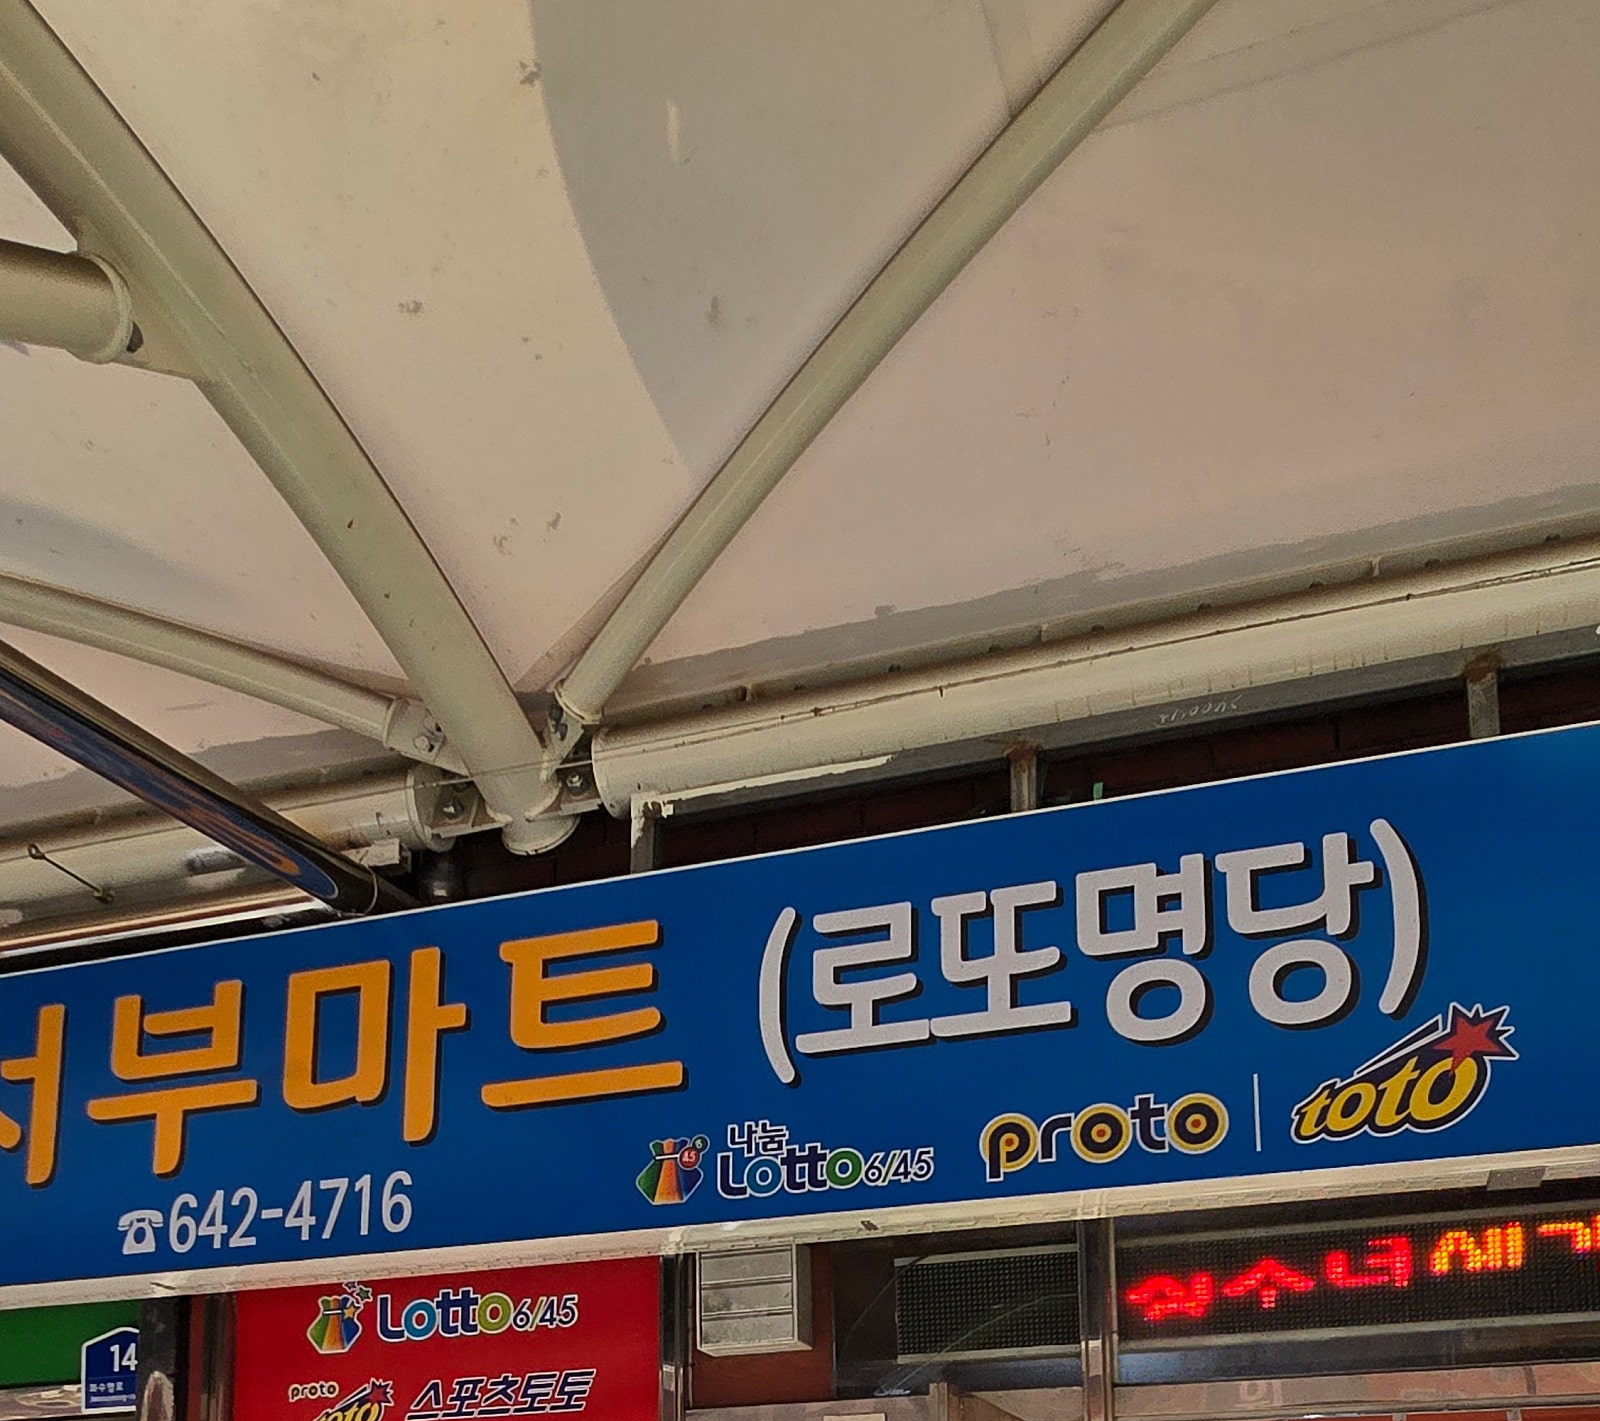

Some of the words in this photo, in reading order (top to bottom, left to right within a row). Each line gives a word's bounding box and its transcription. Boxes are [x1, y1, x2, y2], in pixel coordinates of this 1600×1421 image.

[758, 818, 1424, 1084] (로또명당)
[728, 1120, 790, 1157] 나눔
[980, 1089, 1230, 1183] proto
[1291, 1050, 1492, 1145] toto
[168, 1170, 413, 1256] 642-4716
[109, 1342, 138, 1372] 14
[289, 1380, 340, 1401] proto
